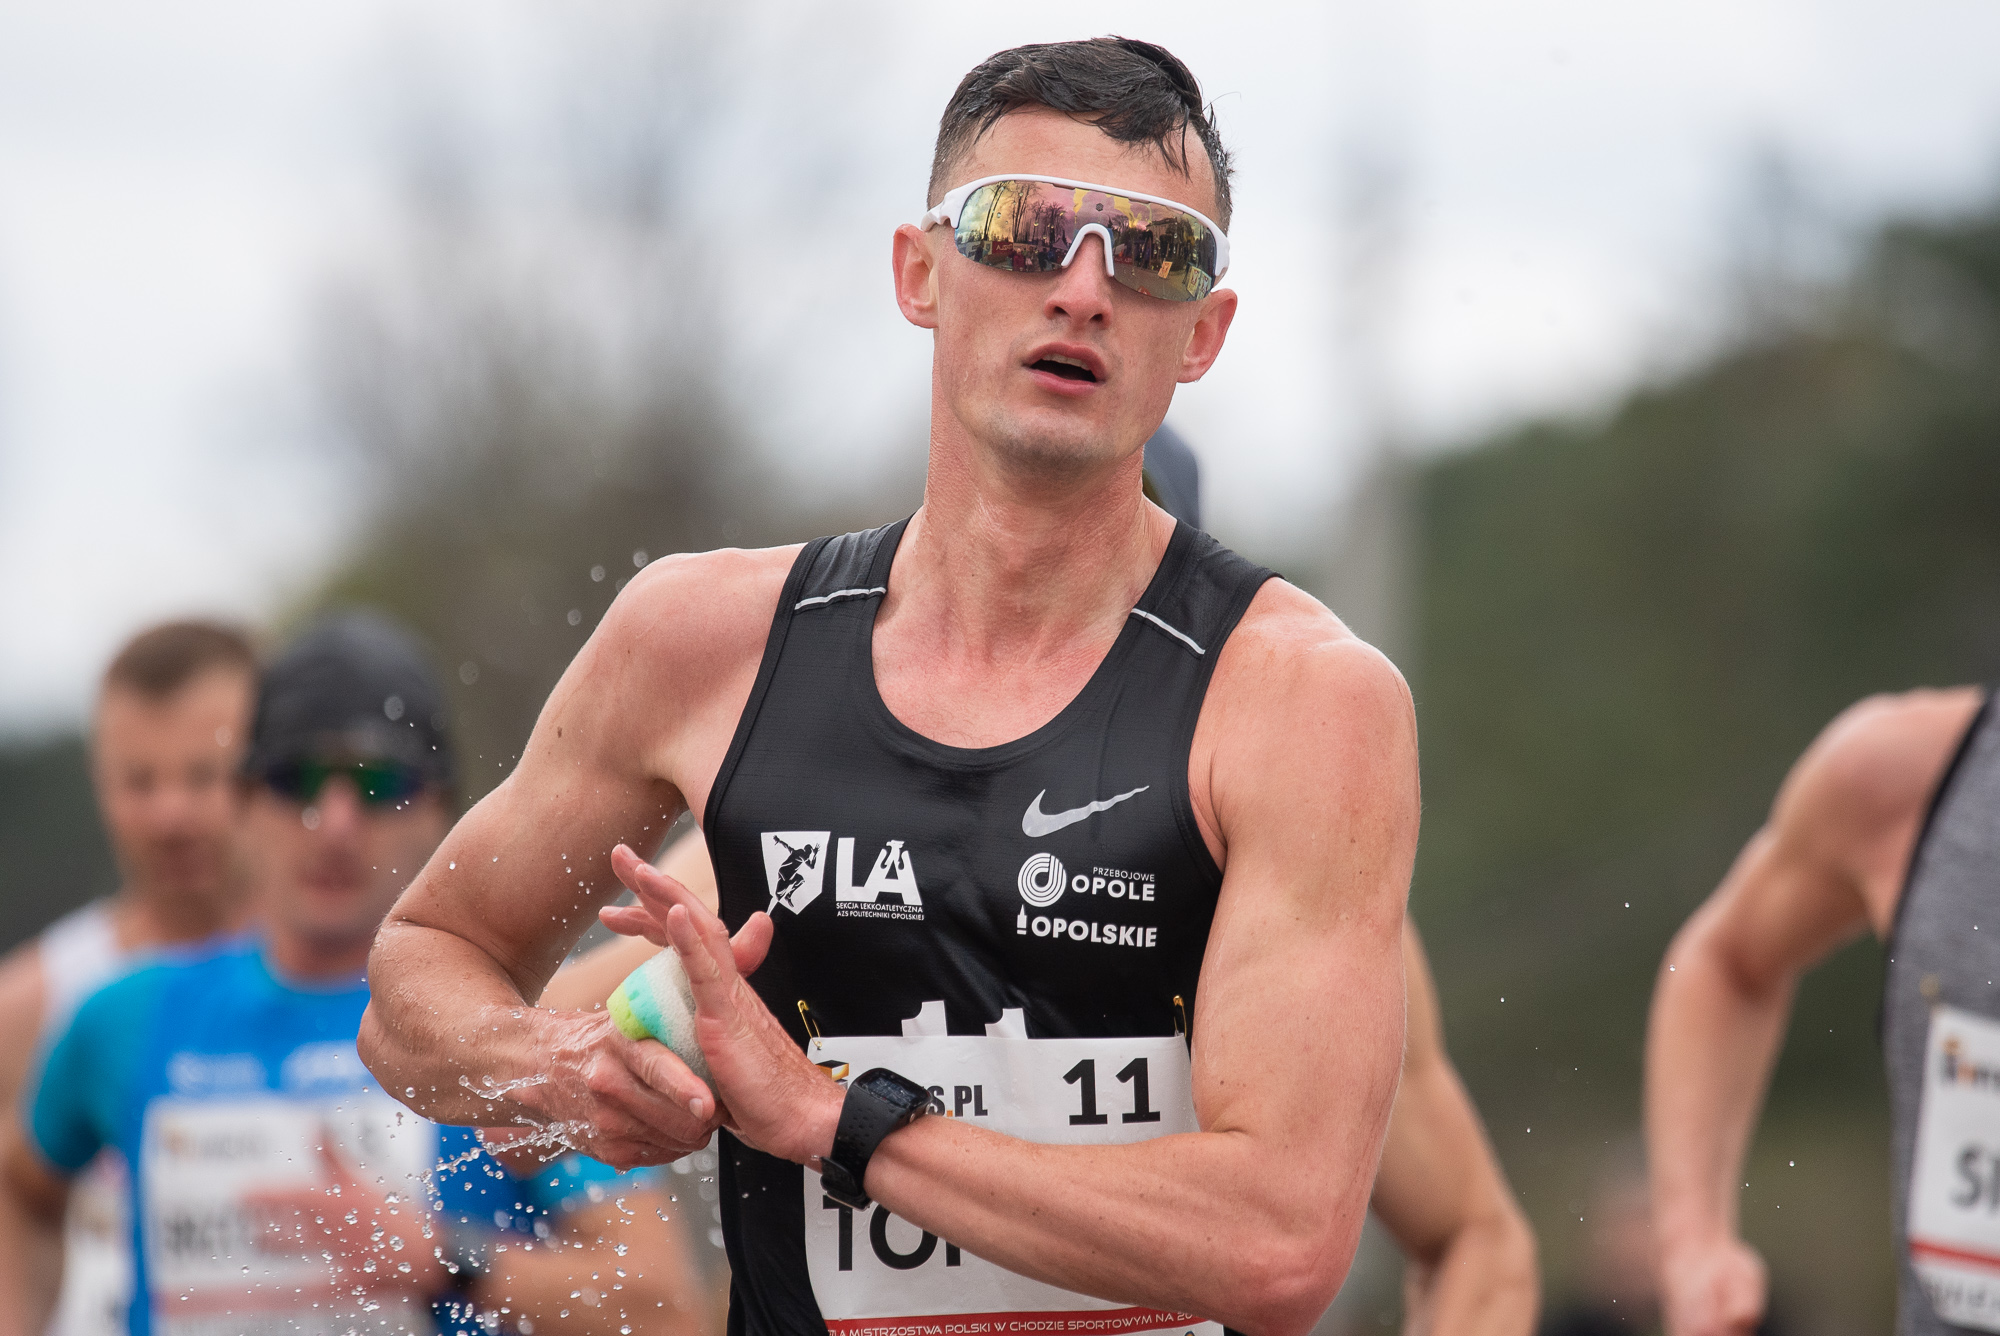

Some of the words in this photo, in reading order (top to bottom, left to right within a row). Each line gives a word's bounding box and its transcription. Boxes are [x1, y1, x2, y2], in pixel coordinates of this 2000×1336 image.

[835, 837, 923, 906] LA
[1092, 866, 1155, 882] PRZEBOJOWE
[1071, 874, 1155, 902] OPOLE
[836, 902, 859, 910] SEKCJA
[860, 903, 923, 913] LEKKOATLETYCZNA
[849, 910, 890, 919] POLITECHNIKI
[891, 913, 925, 921] OPOLSKIEJ
[1031, 916, 1157, 948] OPOLSKIE
[926, 1084, 988, 1118] S.PL
[1062, 1057, 1161, 1126] 11
[945, 1322, 991, 1335] POLSKI
[993, 1321, 1007, 1332] W
[1009, 1320, 1065, 1331] CHODZIE
[1067, 1314, 1153, 1331] SPORTOWYM
[1155, 1312, 1174, 1323] NA
